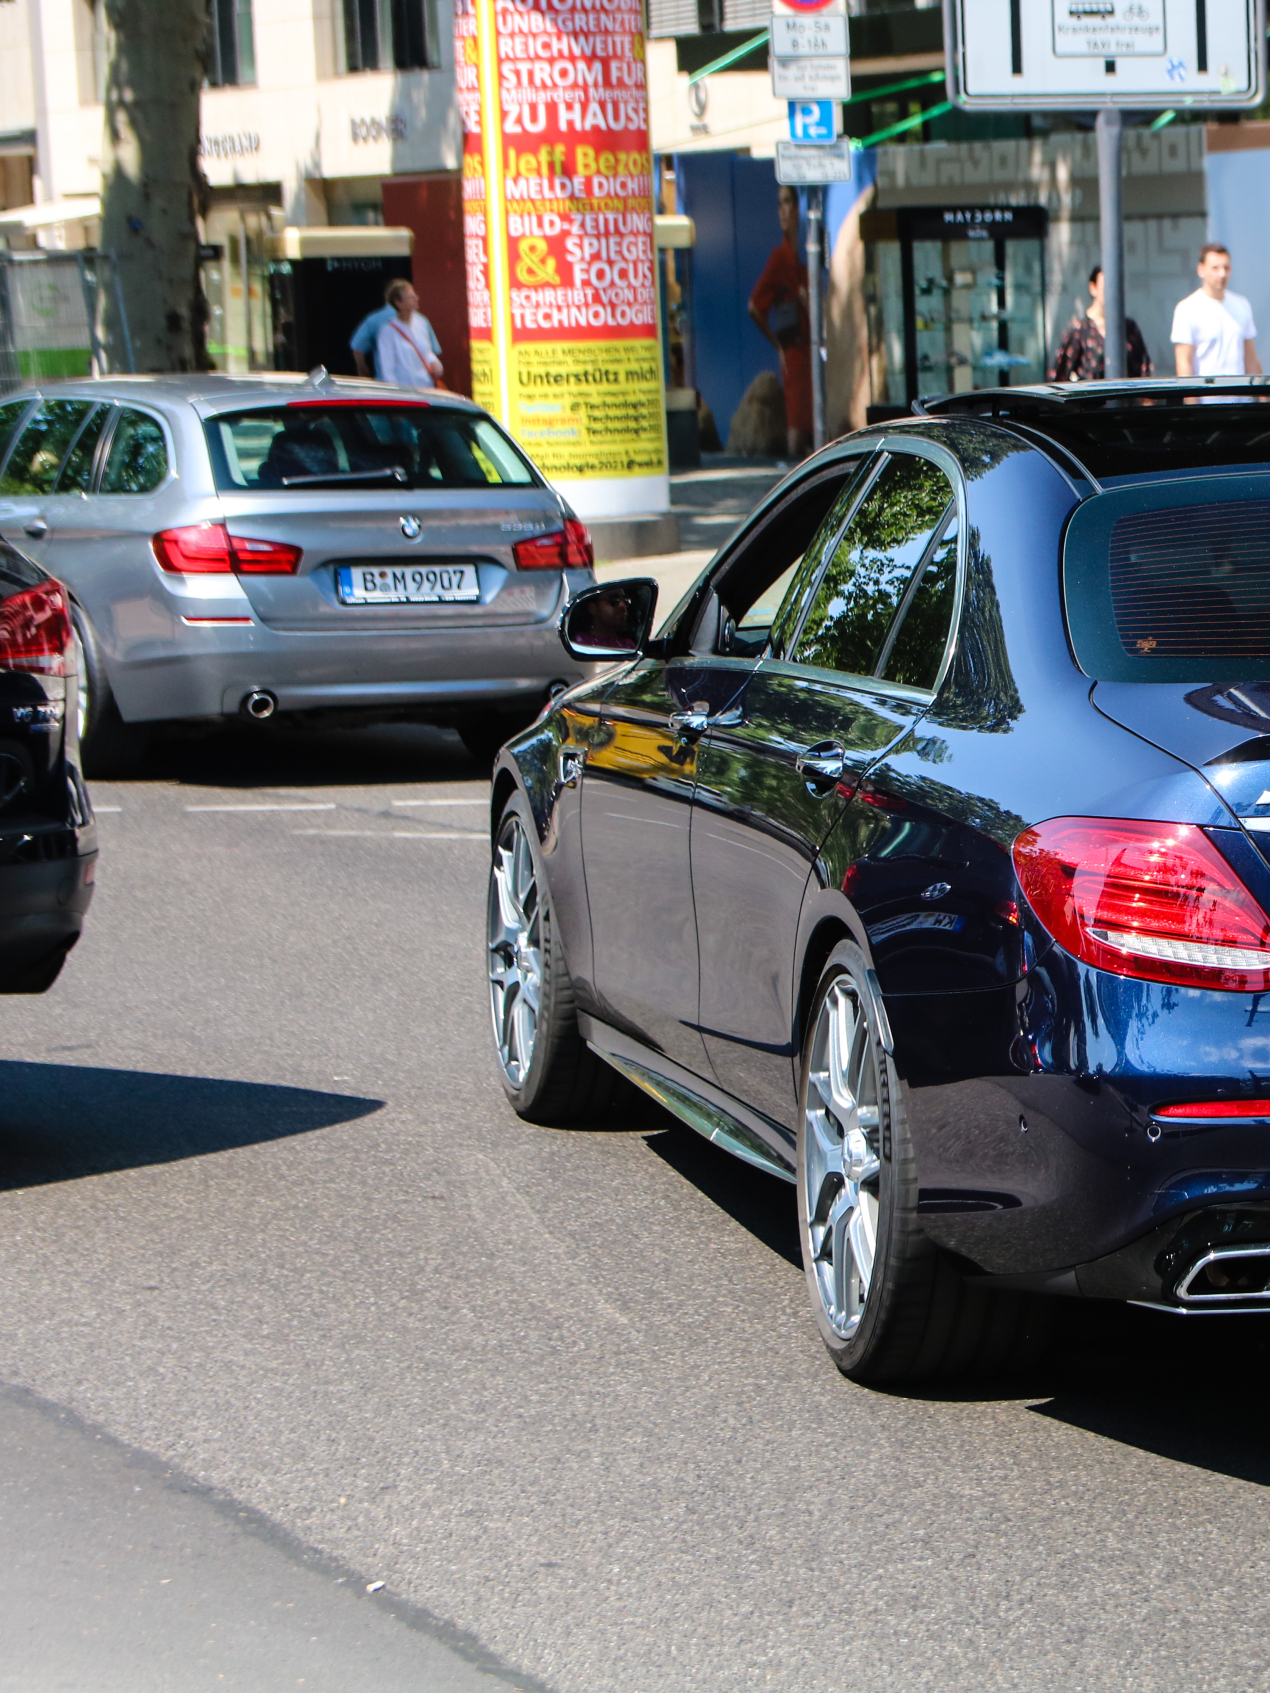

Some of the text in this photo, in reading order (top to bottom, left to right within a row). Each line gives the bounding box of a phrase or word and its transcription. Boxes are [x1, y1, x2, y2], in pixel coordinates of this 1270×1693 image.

[786, 21, 831, 34] Mo-Sa
[1058, 23, 1161, 36] Krankenfahrzeuge
[500, 33, 633, 58] REICHWEITE
[1086, 39, 1135, 51] TAXI frei
[501, 57, 646, 87] STROM FÜR
[502, 87, 585, 103] Milliarden
[503, 103, 547, 133] ZU
[557, 101, 648, 131] HAUSE
[507, 143, 566, 178] Jeff
[574, 145, 651, 176] Bezos
[506, 174, 651, 200] MELDE DICH!!!
[507, 199, 624, 215] WASHINGTON
[508, 211, 652, 236] BILD-ZEITUNG
[515, 235, 561, 286] &
[565, 234, 653, 263] SPIEGEL
[574, 261, 652, 289] FOCUS
[510, 287, 595, 307] SCHREIBT
[600, 286, 635, 304] VON
[511, 304, 657, 328] TECHNOLOGIE!
[518, 367, 619, 387] Unterstütz
[362, 571, 376, 592] B
[392, 571, 407, 592] M
[411, 570, 465, 592] 9907
